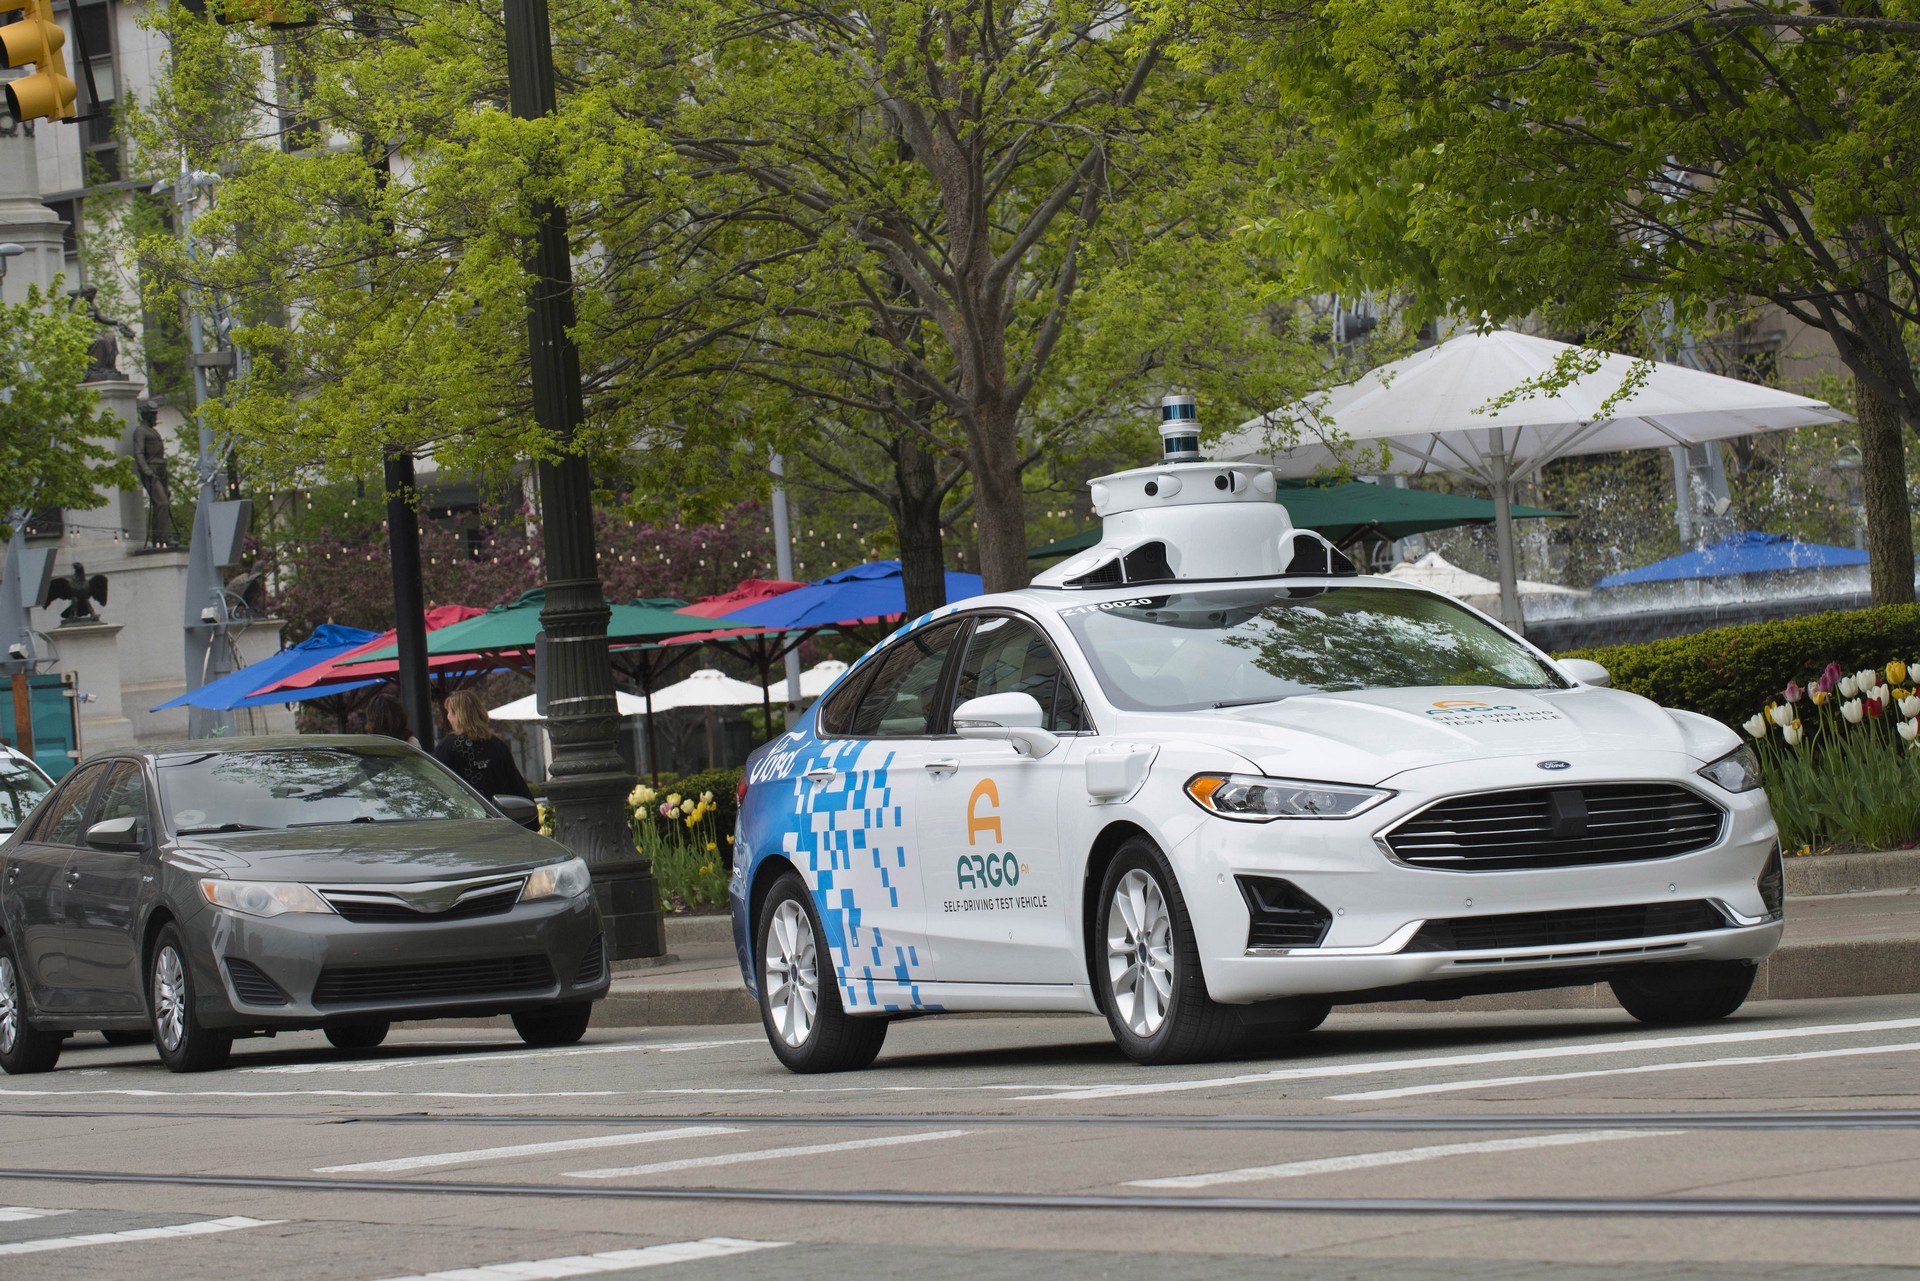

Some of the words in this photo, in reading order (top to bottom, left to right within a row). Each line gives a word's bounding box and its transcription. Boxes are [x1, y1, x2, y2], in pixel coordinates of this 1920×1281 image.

[750, 730, 812, 784] Ford
[957, 851, 1019, 890] ARGO
[943, 898, 994, 912] SELF-DRIVING
[995, 897, 1013, 910] TEST
[1015, 895, 1048, 908] VEHICLE
